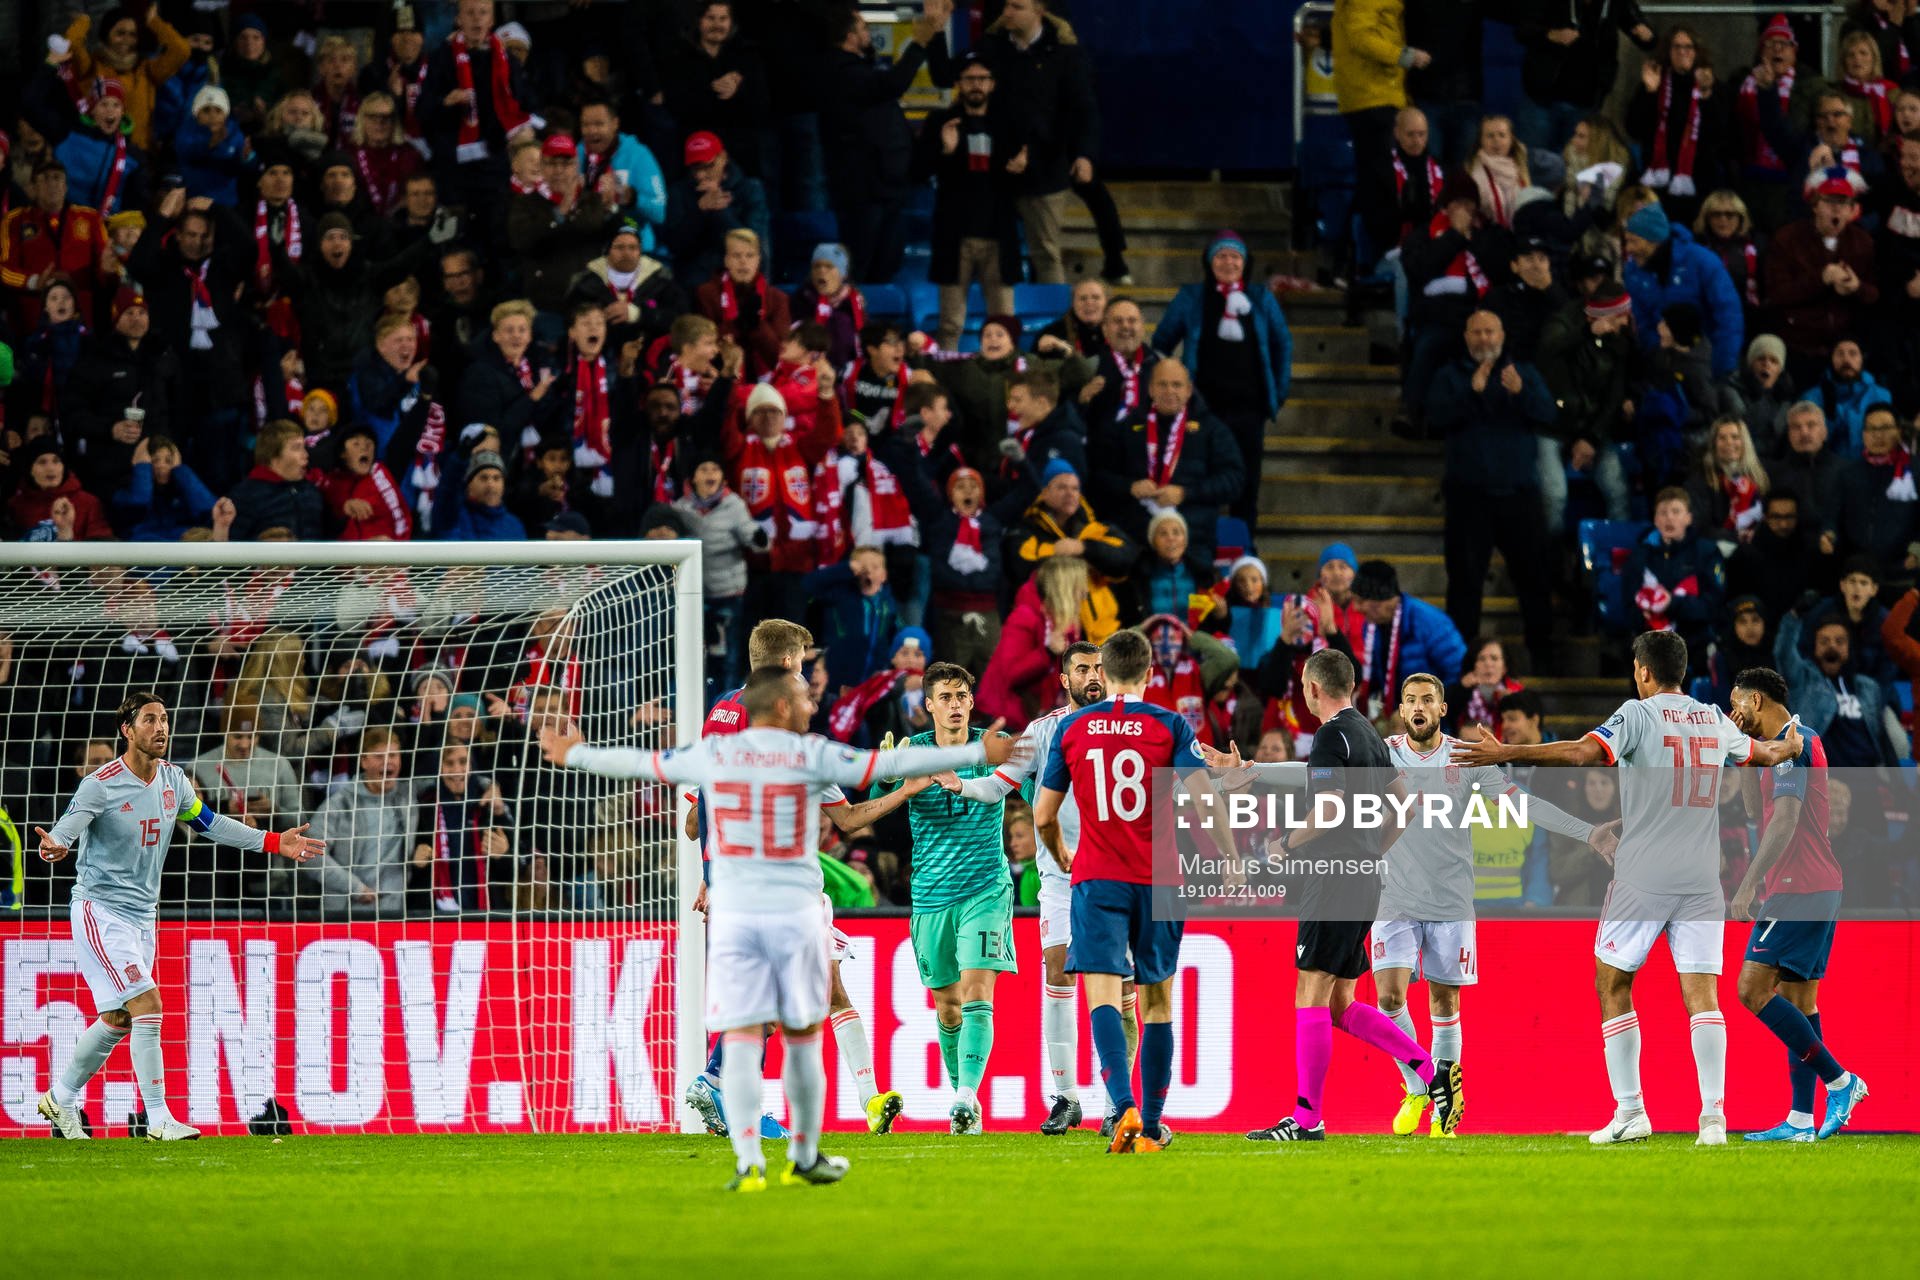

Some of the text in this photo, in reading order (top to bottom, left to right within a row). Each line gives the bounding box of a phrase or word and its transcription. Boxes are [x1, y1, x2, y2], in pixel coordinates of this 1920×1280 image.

[1087, 719, 1143, 736] SELNÆS
[1085, 748, 1147, 822] 18
[1663, 735, 1719, 808] 16
[140, 818, 161, 848] 15
[713, 782, 807, 859] 20
[977, 930, 1003, 958] 13
[1758, 916, 1778, 943] 7
[188, 939, 522, 1125] NOV.
